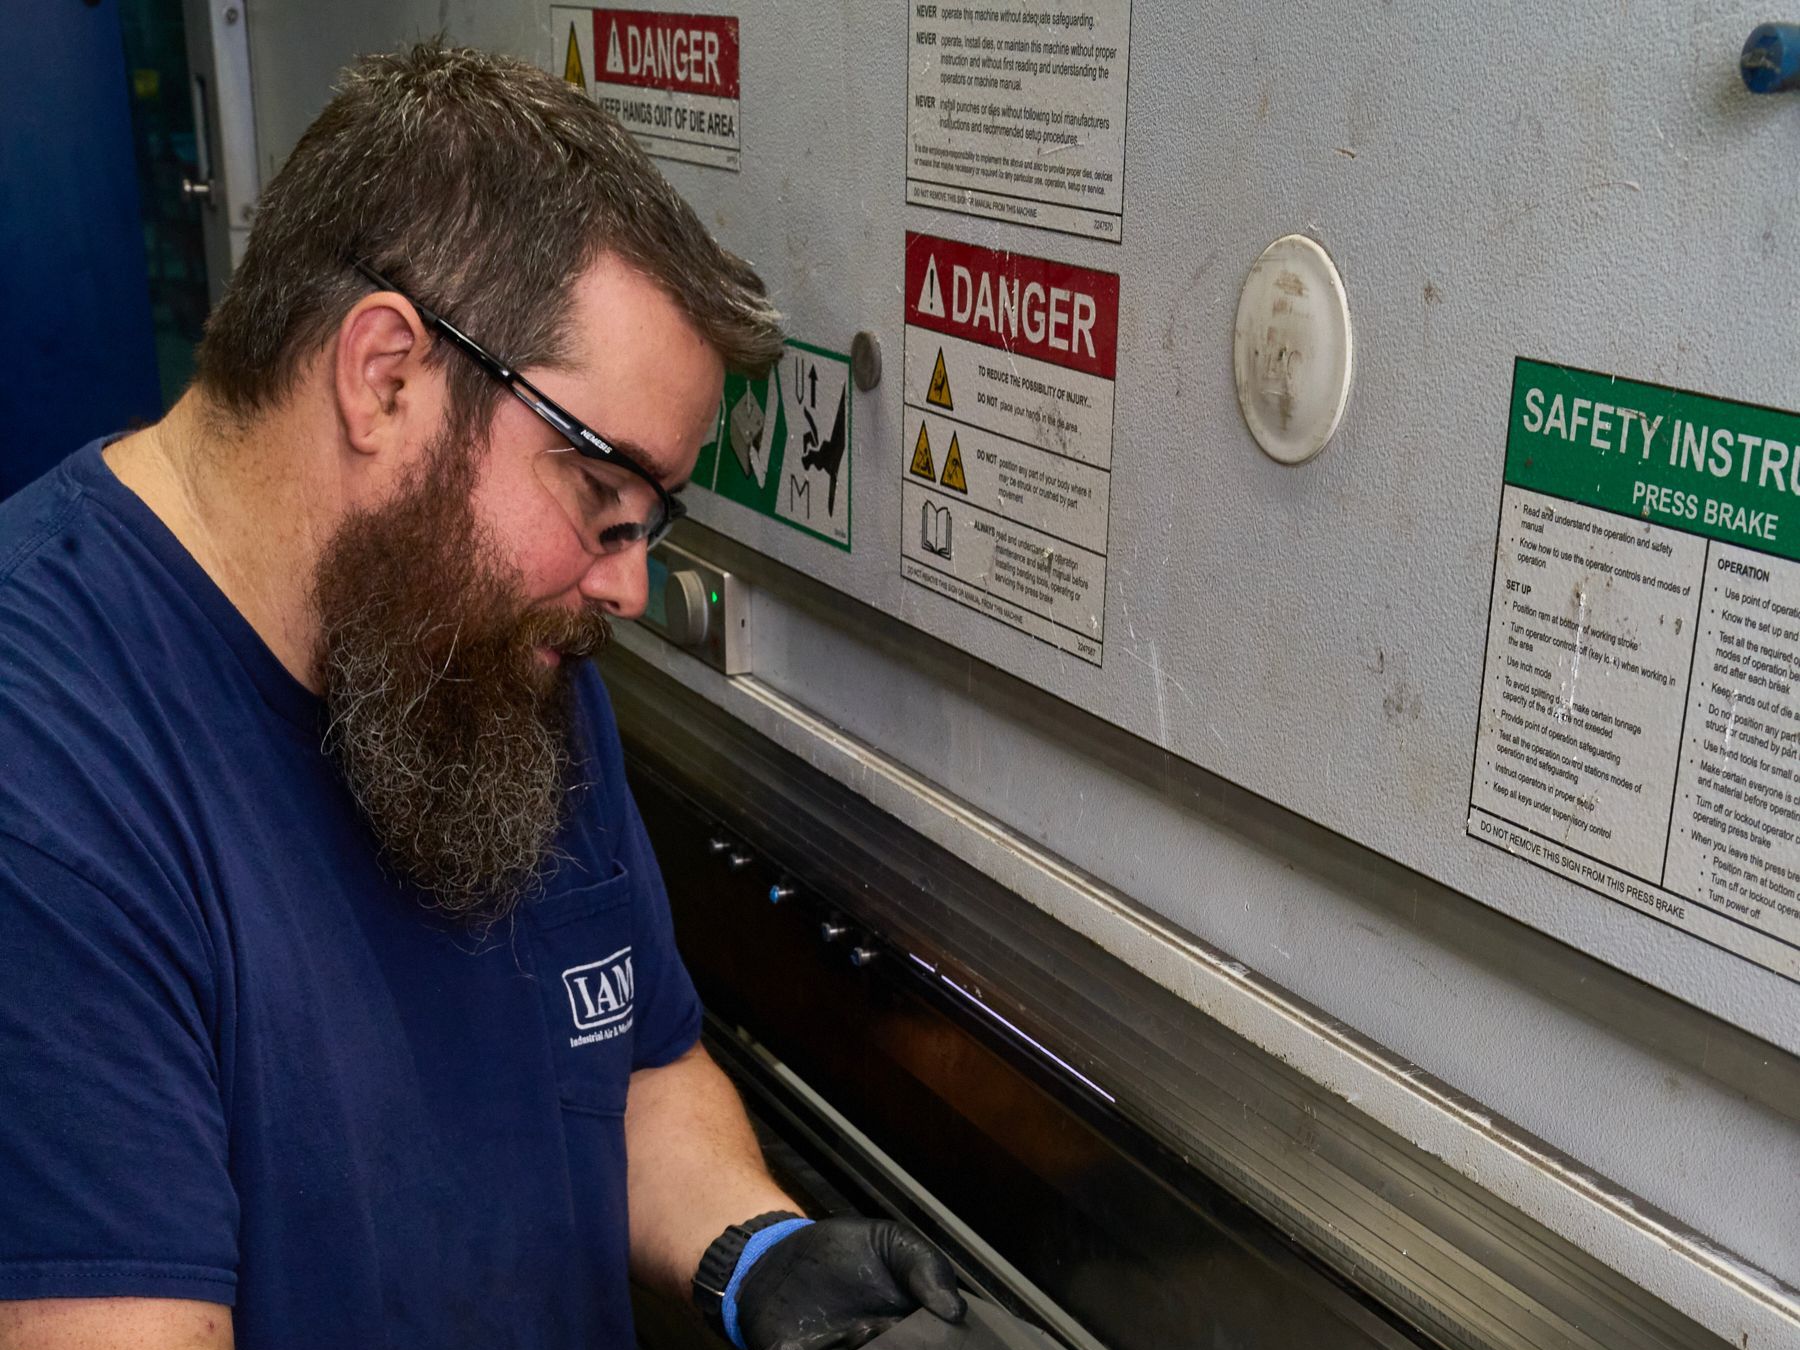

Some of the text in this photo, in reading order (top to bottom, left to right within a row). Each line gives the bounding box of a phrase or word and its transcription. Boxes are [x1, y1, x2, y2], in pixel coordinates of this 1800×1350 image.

[627, 24, 721, 85] DANGER
[622, 102, 653, 126] HANDS
[655, 107, 673, 130] OUT
[675, 110, 687, 131] OF
[689, 112, 704, 132] DIE
[707, 113, 735, 138] AREA
[952, 264, 1097, 358] DANGER
[978, 365, 985, 377] TO
[987, 368, 1008, 384] REDUCE
[1010, 374, 1020, 387] THE
[1022, 377, 1056, 397] POSSIBILITY
[1056, 387, 1065, 400] OF
[580, 429, 613, 454] NEMESIS
[1522, 387, 1663, 460] SAFETY
[1521, 518, 1544, 533] manual
[1523, 504, 1540, 518] Read
[1541, 509, 1553, 521] and
[1554, 513, 1590, 532] understand
[1591, 523, 1602, 535] the
[1603, 526, 1635, 546] operation
[1636, 535, 1650, 548] and
[1632, 480, 1779, 541] PRESS BRAKE
[1506, 579, 1531, 595] SET UP
[1519, 537, 1690, 596] Know how to use the operator controls and modes of
[1717, 558, 1769, 582] OPERATION
[1724, 587, 1770, 609] Use point of
[1512, 600, 1537, 617] Position
[1538, 611, 1550, 621] ram
[1551, 613, 1558, 624] at
[1582, 623, 1590, 634] of
[1590, 625, 1616, 645] working
[1617, 634, 1638, 650] stroke
[1721, 609, 1798, 641] Know the set up and
[1506, 655, 1551, 679] Use inch mode
[1713, 661, 1790, 694] and after each break
[1500, 709, 1621, 765] Provide point of operation safeguarding
[1705, 718, 1727, 734] struck
[1738, 730, 1768, 749] crushed
[1769, 741, 1780, 755] by
[1781, 745, 1797, 761] part
[1495, 762, 1516, 778] Instruct
[1517, 771, 1546, 793] operators
[1547, 783, 1553, 793] in
[1554, 788, 1575, 805] proper
[1492, 781, 1611, 839] Keep all keys under supervisory control
[1692, 809, 1771, 848] operating press brake
[1480, 820, 1685, 920] DO NOT REMOVE THIS SIGN FROM THIS PRESS BRAKE
[1707, 888, 1760, 920] Turn power off
